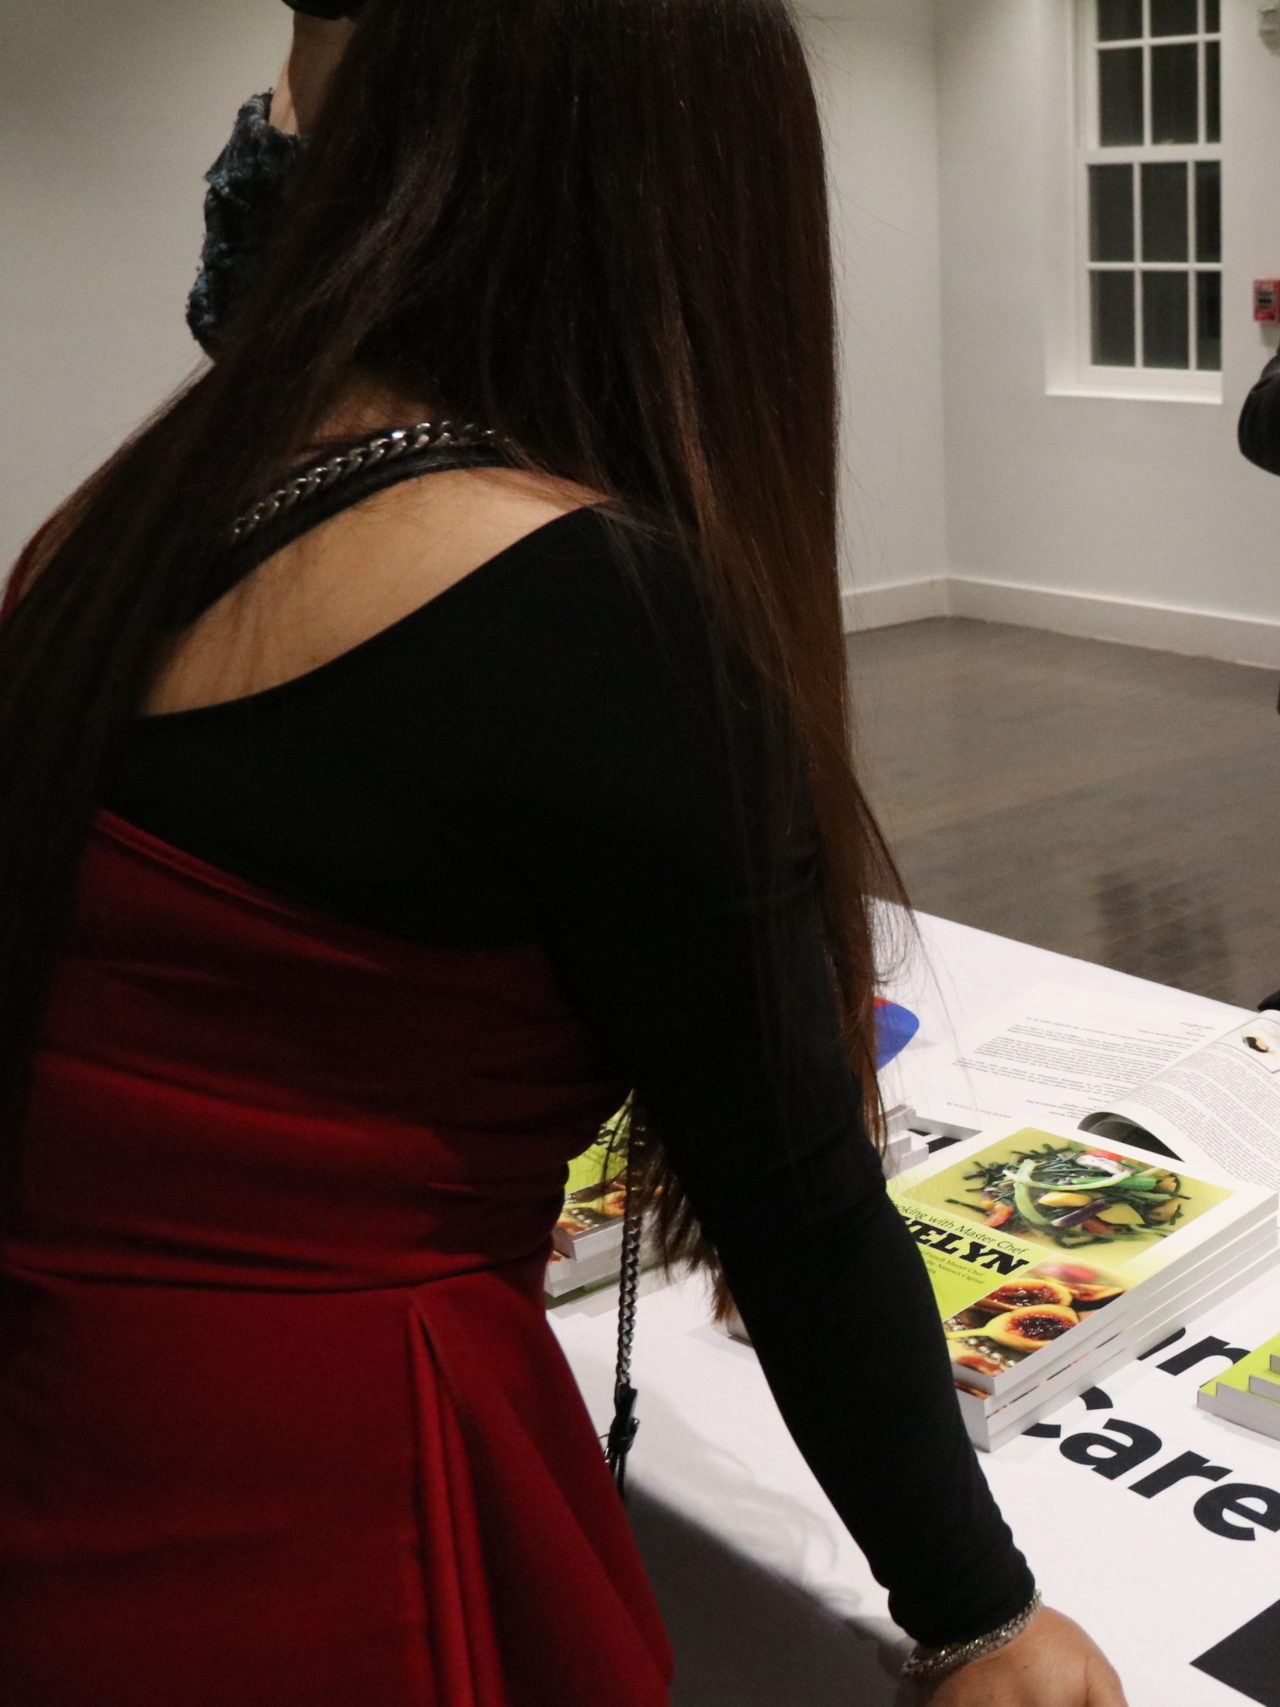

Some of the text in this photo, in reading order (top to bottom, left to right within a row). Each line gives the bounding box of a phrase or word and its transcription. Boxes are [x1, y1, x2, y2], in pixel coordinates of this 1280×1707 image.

[929, 1215, 955, 1230] with
[955, 1225, 996, 1244] Master
[997, 1240, 1030, 1255] Chef
